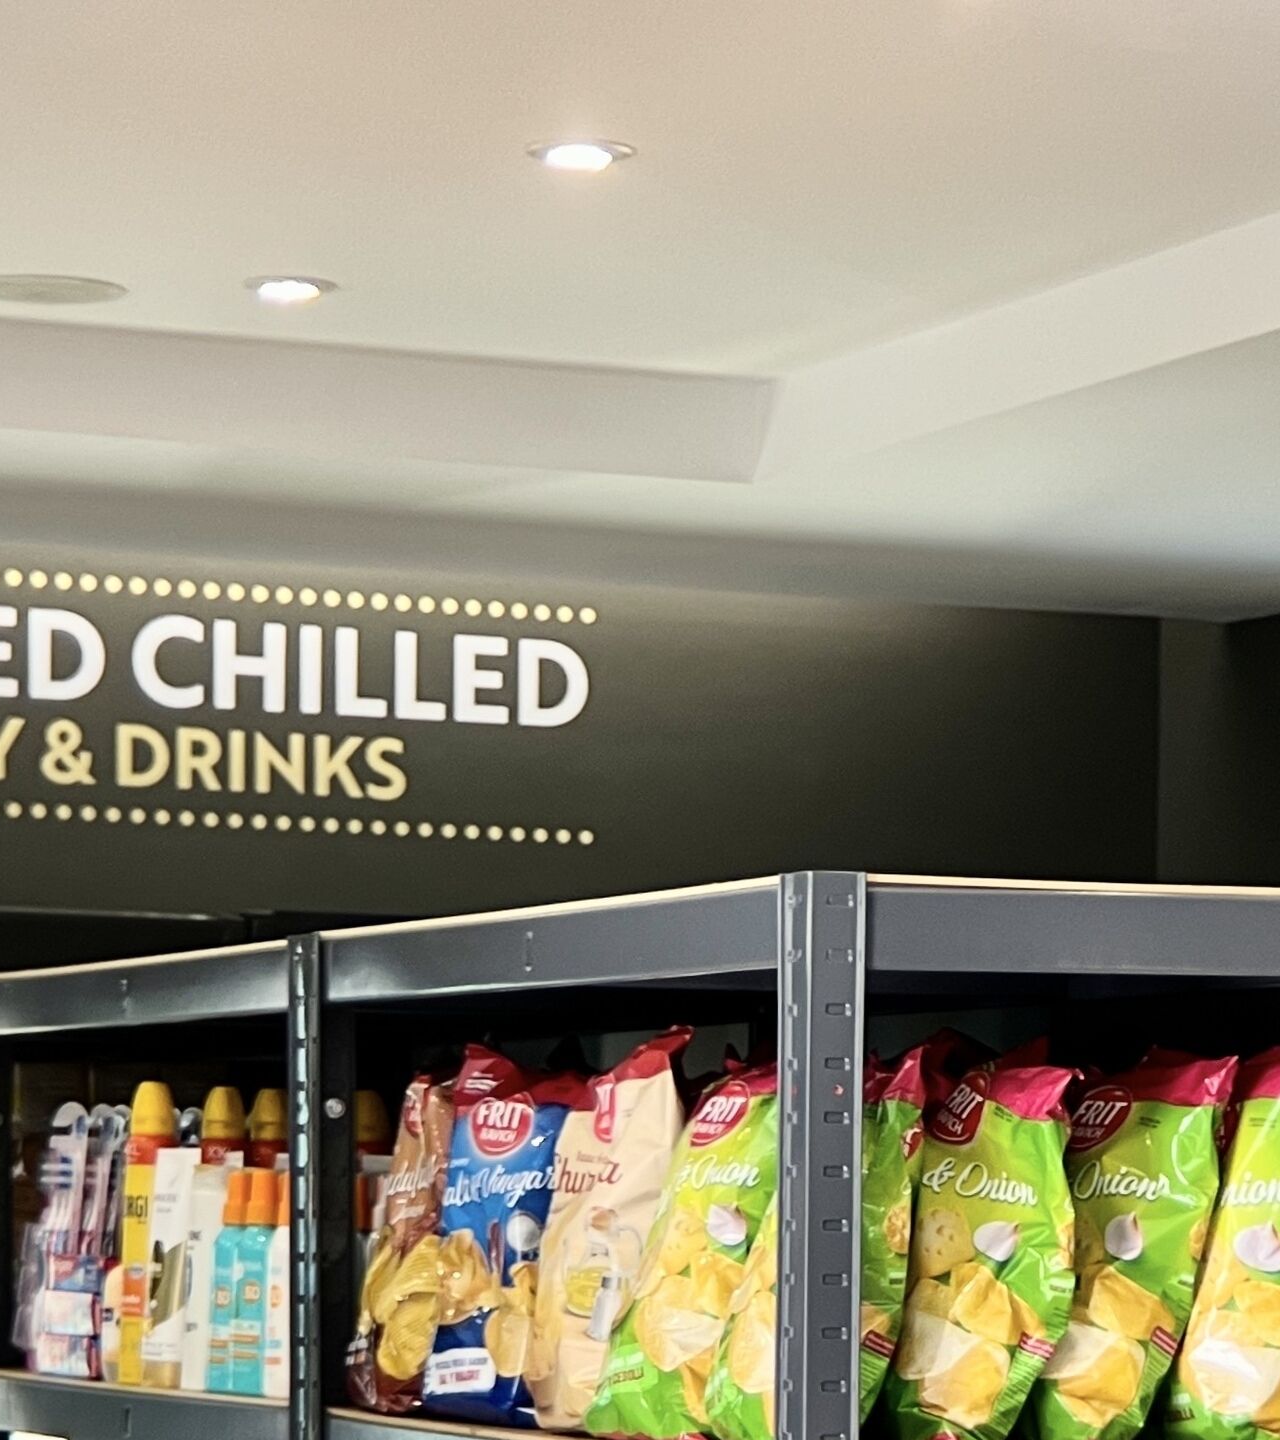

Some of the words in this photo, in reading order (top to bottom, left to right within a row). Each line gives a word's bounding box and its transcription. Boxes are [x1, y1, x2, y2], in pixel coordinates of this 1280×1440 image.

[131, 613, 590, 728] CHILLED
[39, 716, 97, 786] &
[114, 721, 408, 801] DRINKS
[476, 1099, 533, 1130] FRIT
[697, 1095, 749, 1123] FRIT
[945, 1082, 985, 1120] FRIT
[1072, 1099, 1128, 1126] FRIT
[921, 1156, 957, 1194] &
[954, 1160, 1040, 1206] Onion
